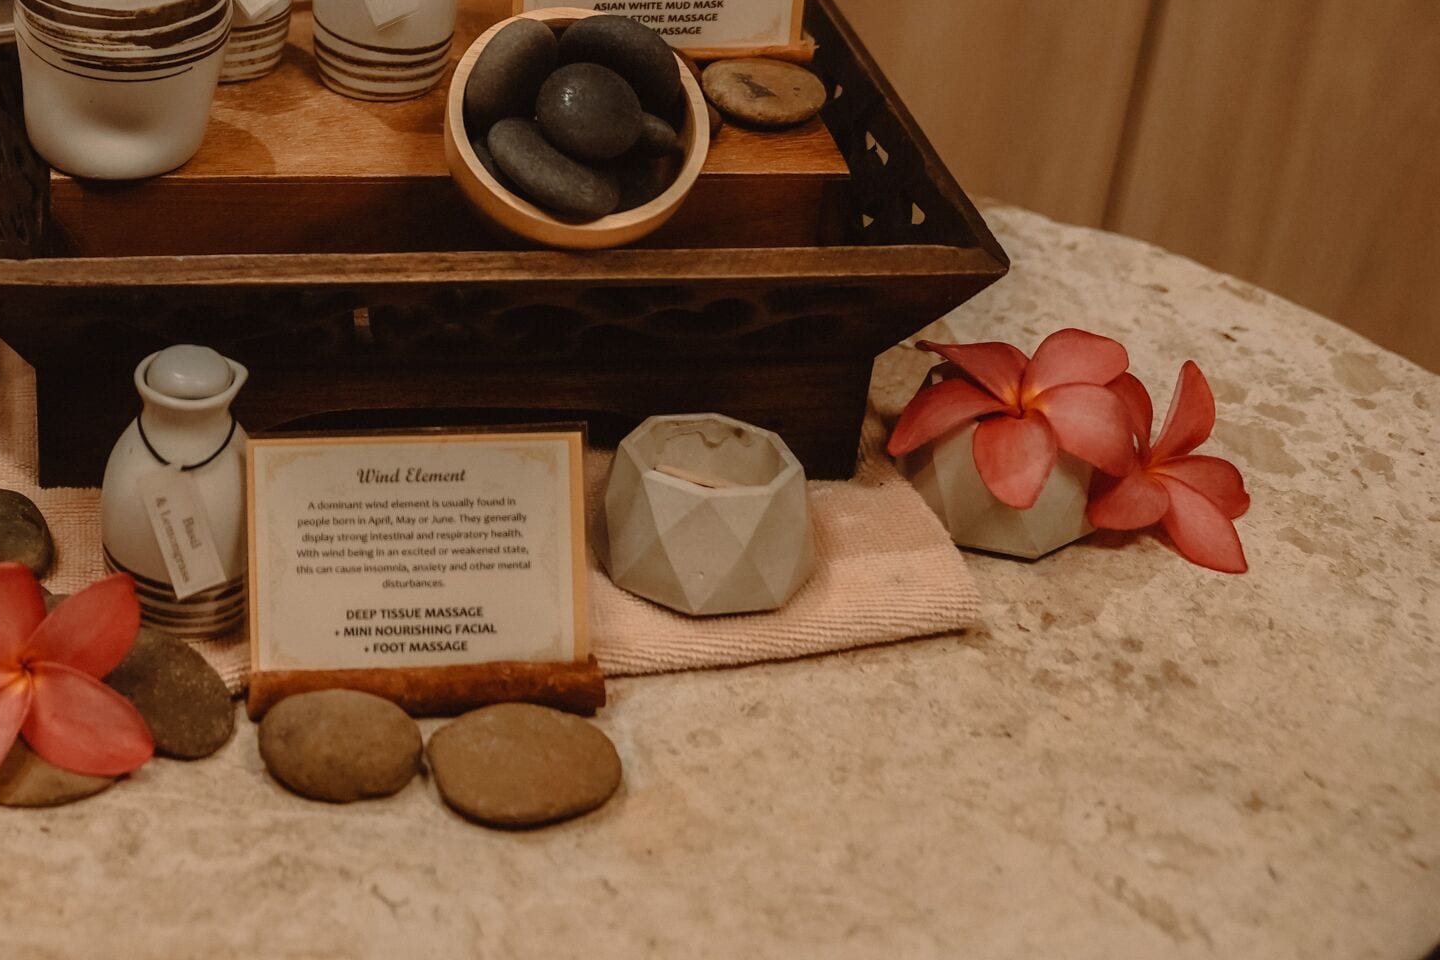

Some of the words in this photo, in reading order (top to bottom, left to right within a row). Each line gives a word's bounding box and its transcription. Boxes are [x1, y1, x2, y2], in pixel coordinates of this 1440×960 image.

[592, 2, 626, 11] ASIAN
[628, 1, 663, 10] WHITE
[665, 1, 691, 10] MUD
[693, 0, 724, 9] MASK
[667, 13, 719, 23] MASSAGE
[356, 467, 400, 484] Wind
[405, 467, 466, 483] Element
[317, 500, 363, 511] dominant
[364, 499, 389, 510] wind
[390, 499, 430, 509] element
[441, 498, 474, 509] usually
[476, 496, 506, 507] found
[346, 609, 377, 621] DEEP
[379, 608, 421, 619] TISSUE
[424, 606, 484, 618] MASSAGE
[343, 626, 372, 637] MINI
[375, 624, 452, 636] NOURISHING
[455, 623, 498, 634] FACIAL
[373, 642, 406, 654] FOOT
[409, 640, 468, 652] MASSAGE
